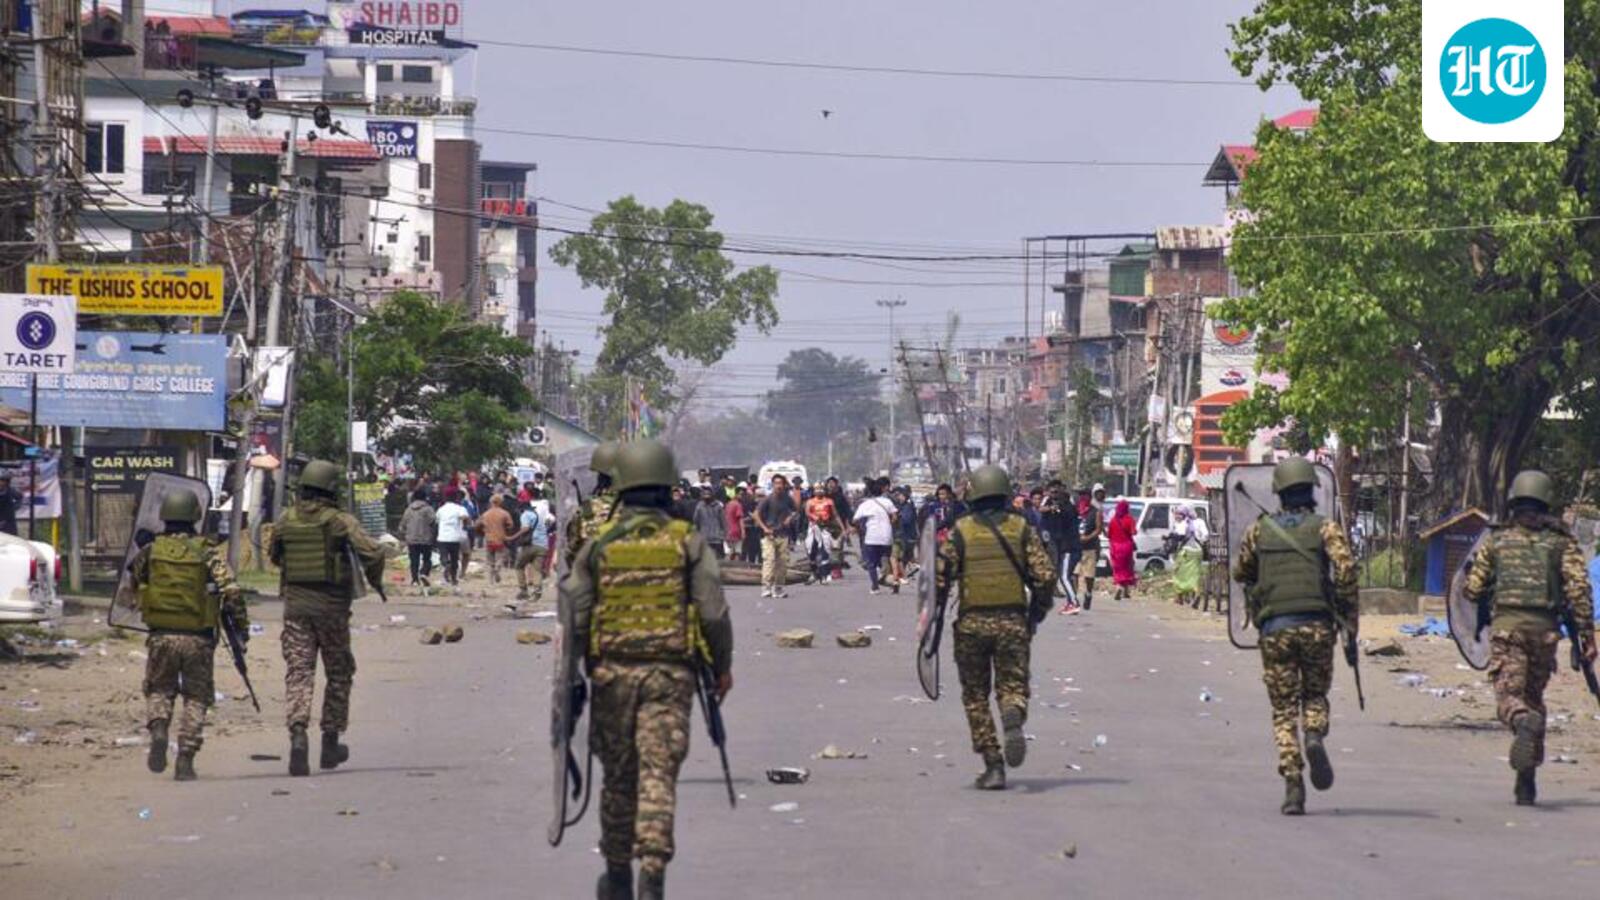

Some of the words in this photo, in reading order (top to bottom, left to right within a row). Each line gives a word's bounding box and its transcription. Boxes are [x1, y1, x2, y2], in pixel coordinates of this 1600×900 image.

[361, 2, 459, 26] SHAIBO
[361, 30, 438, 45] HOSPITAL
[38, 277, 73, 295] THE
[79, 279, 135, 298] USHUS
[141, 279, 214, 300] SCHOOL
[4, 352, 67, 368] TARET
[170, 376, 215, 393] COLLEGE
[92, 457, 124, 468] CAR
[126, 456, 174, 468] WASH
